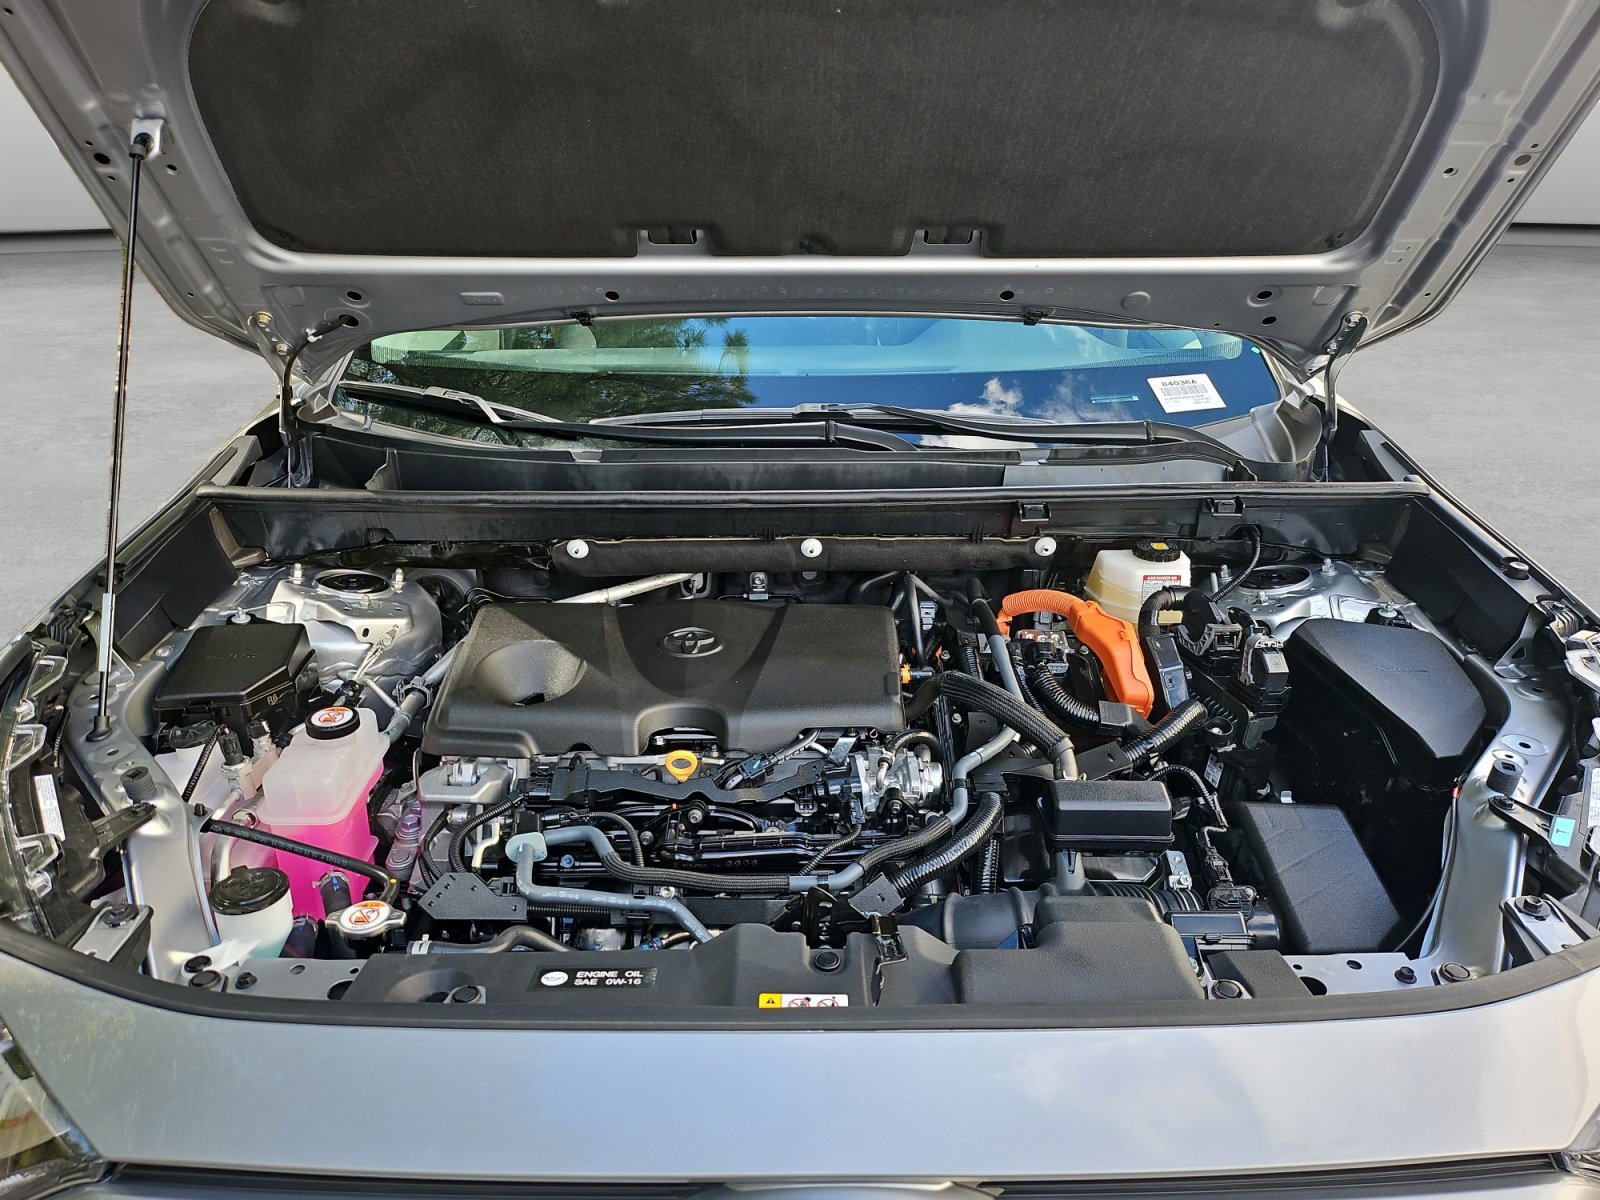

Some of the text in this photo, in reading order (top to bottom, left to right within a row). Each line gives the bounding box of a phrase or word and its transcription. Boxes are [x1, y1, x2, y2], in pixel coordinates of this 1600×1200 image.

[576, 970, 644, 978] ENGINE OIL
[573, 978, 599, 986] SAE
[605, 978, 642, 986] 0W-16
